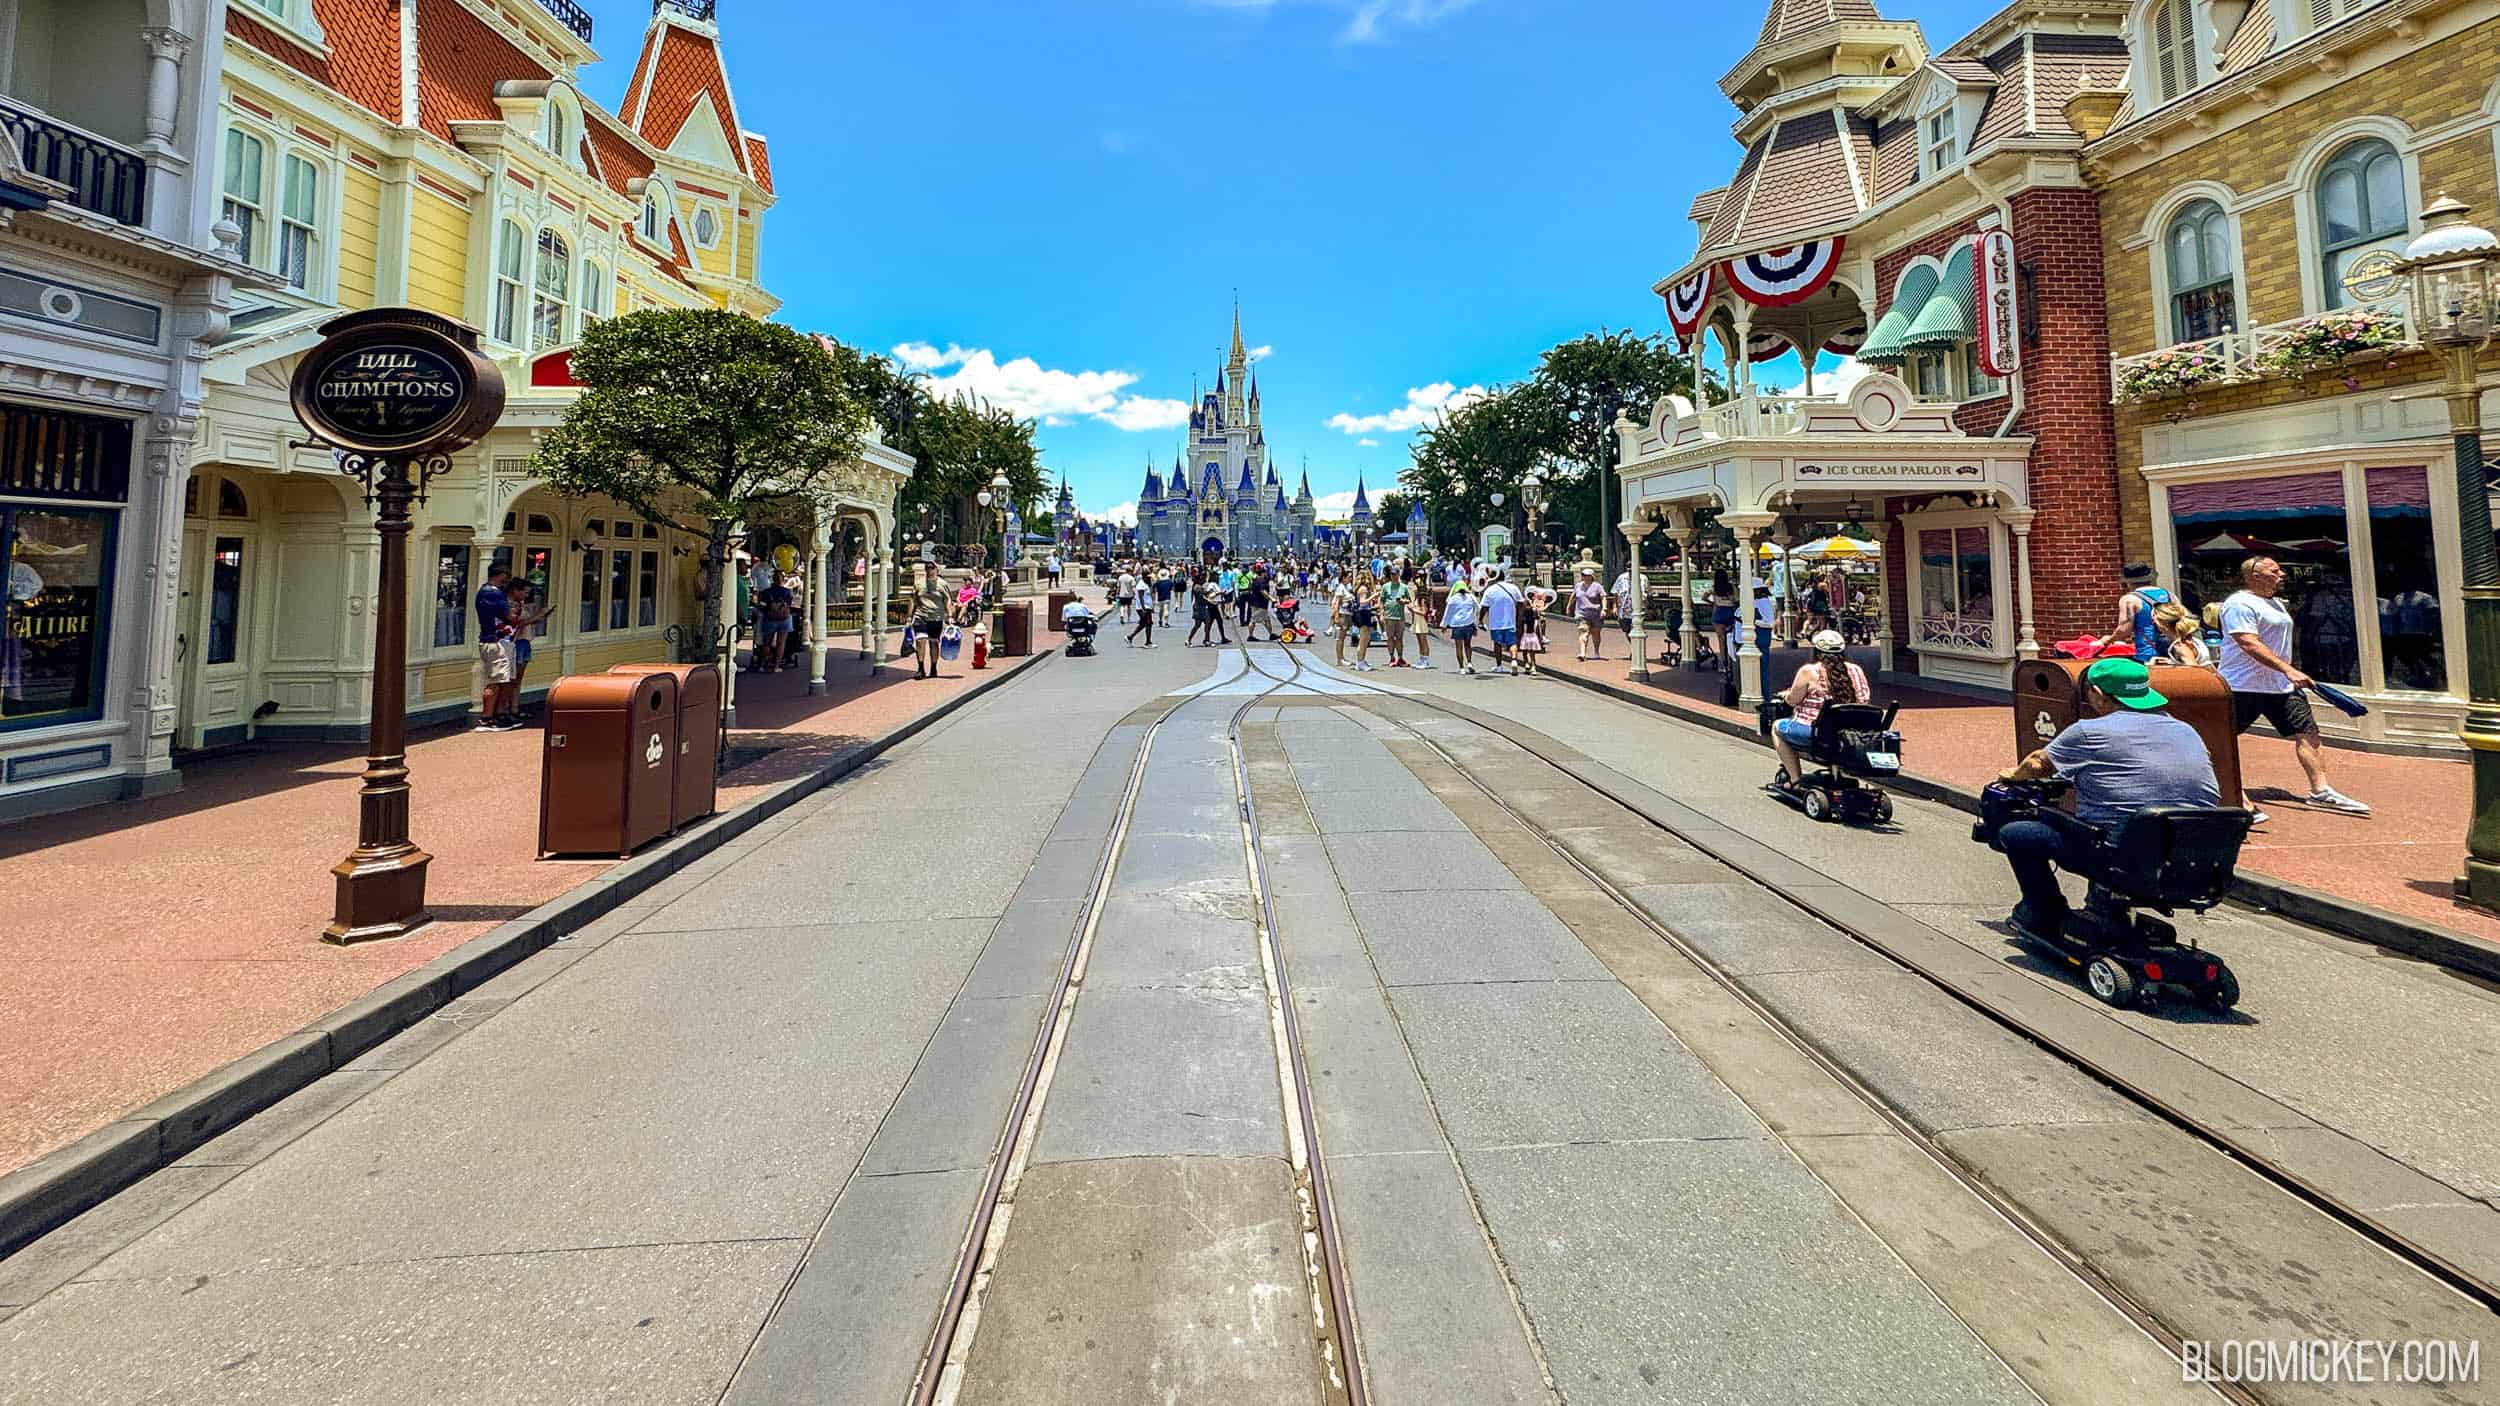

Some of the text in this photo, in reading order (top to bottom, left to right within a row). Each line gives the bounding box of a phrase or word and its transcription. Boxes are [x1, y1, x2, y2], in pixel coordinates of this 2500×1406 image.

[1991, 234, 2009, 283] ICE
[356, 353, 417, 369] HALL
[378, 368, 394, 379] of
[320, 381, 455, 398] CHAMPIONS
[1827, 466, 1848, 475] ICE
[1852, 465, 1897, 475] CREAM
[1900, 465, 1953, 475] PARLOR
[13, 615, 91, 639] ATTIRE
